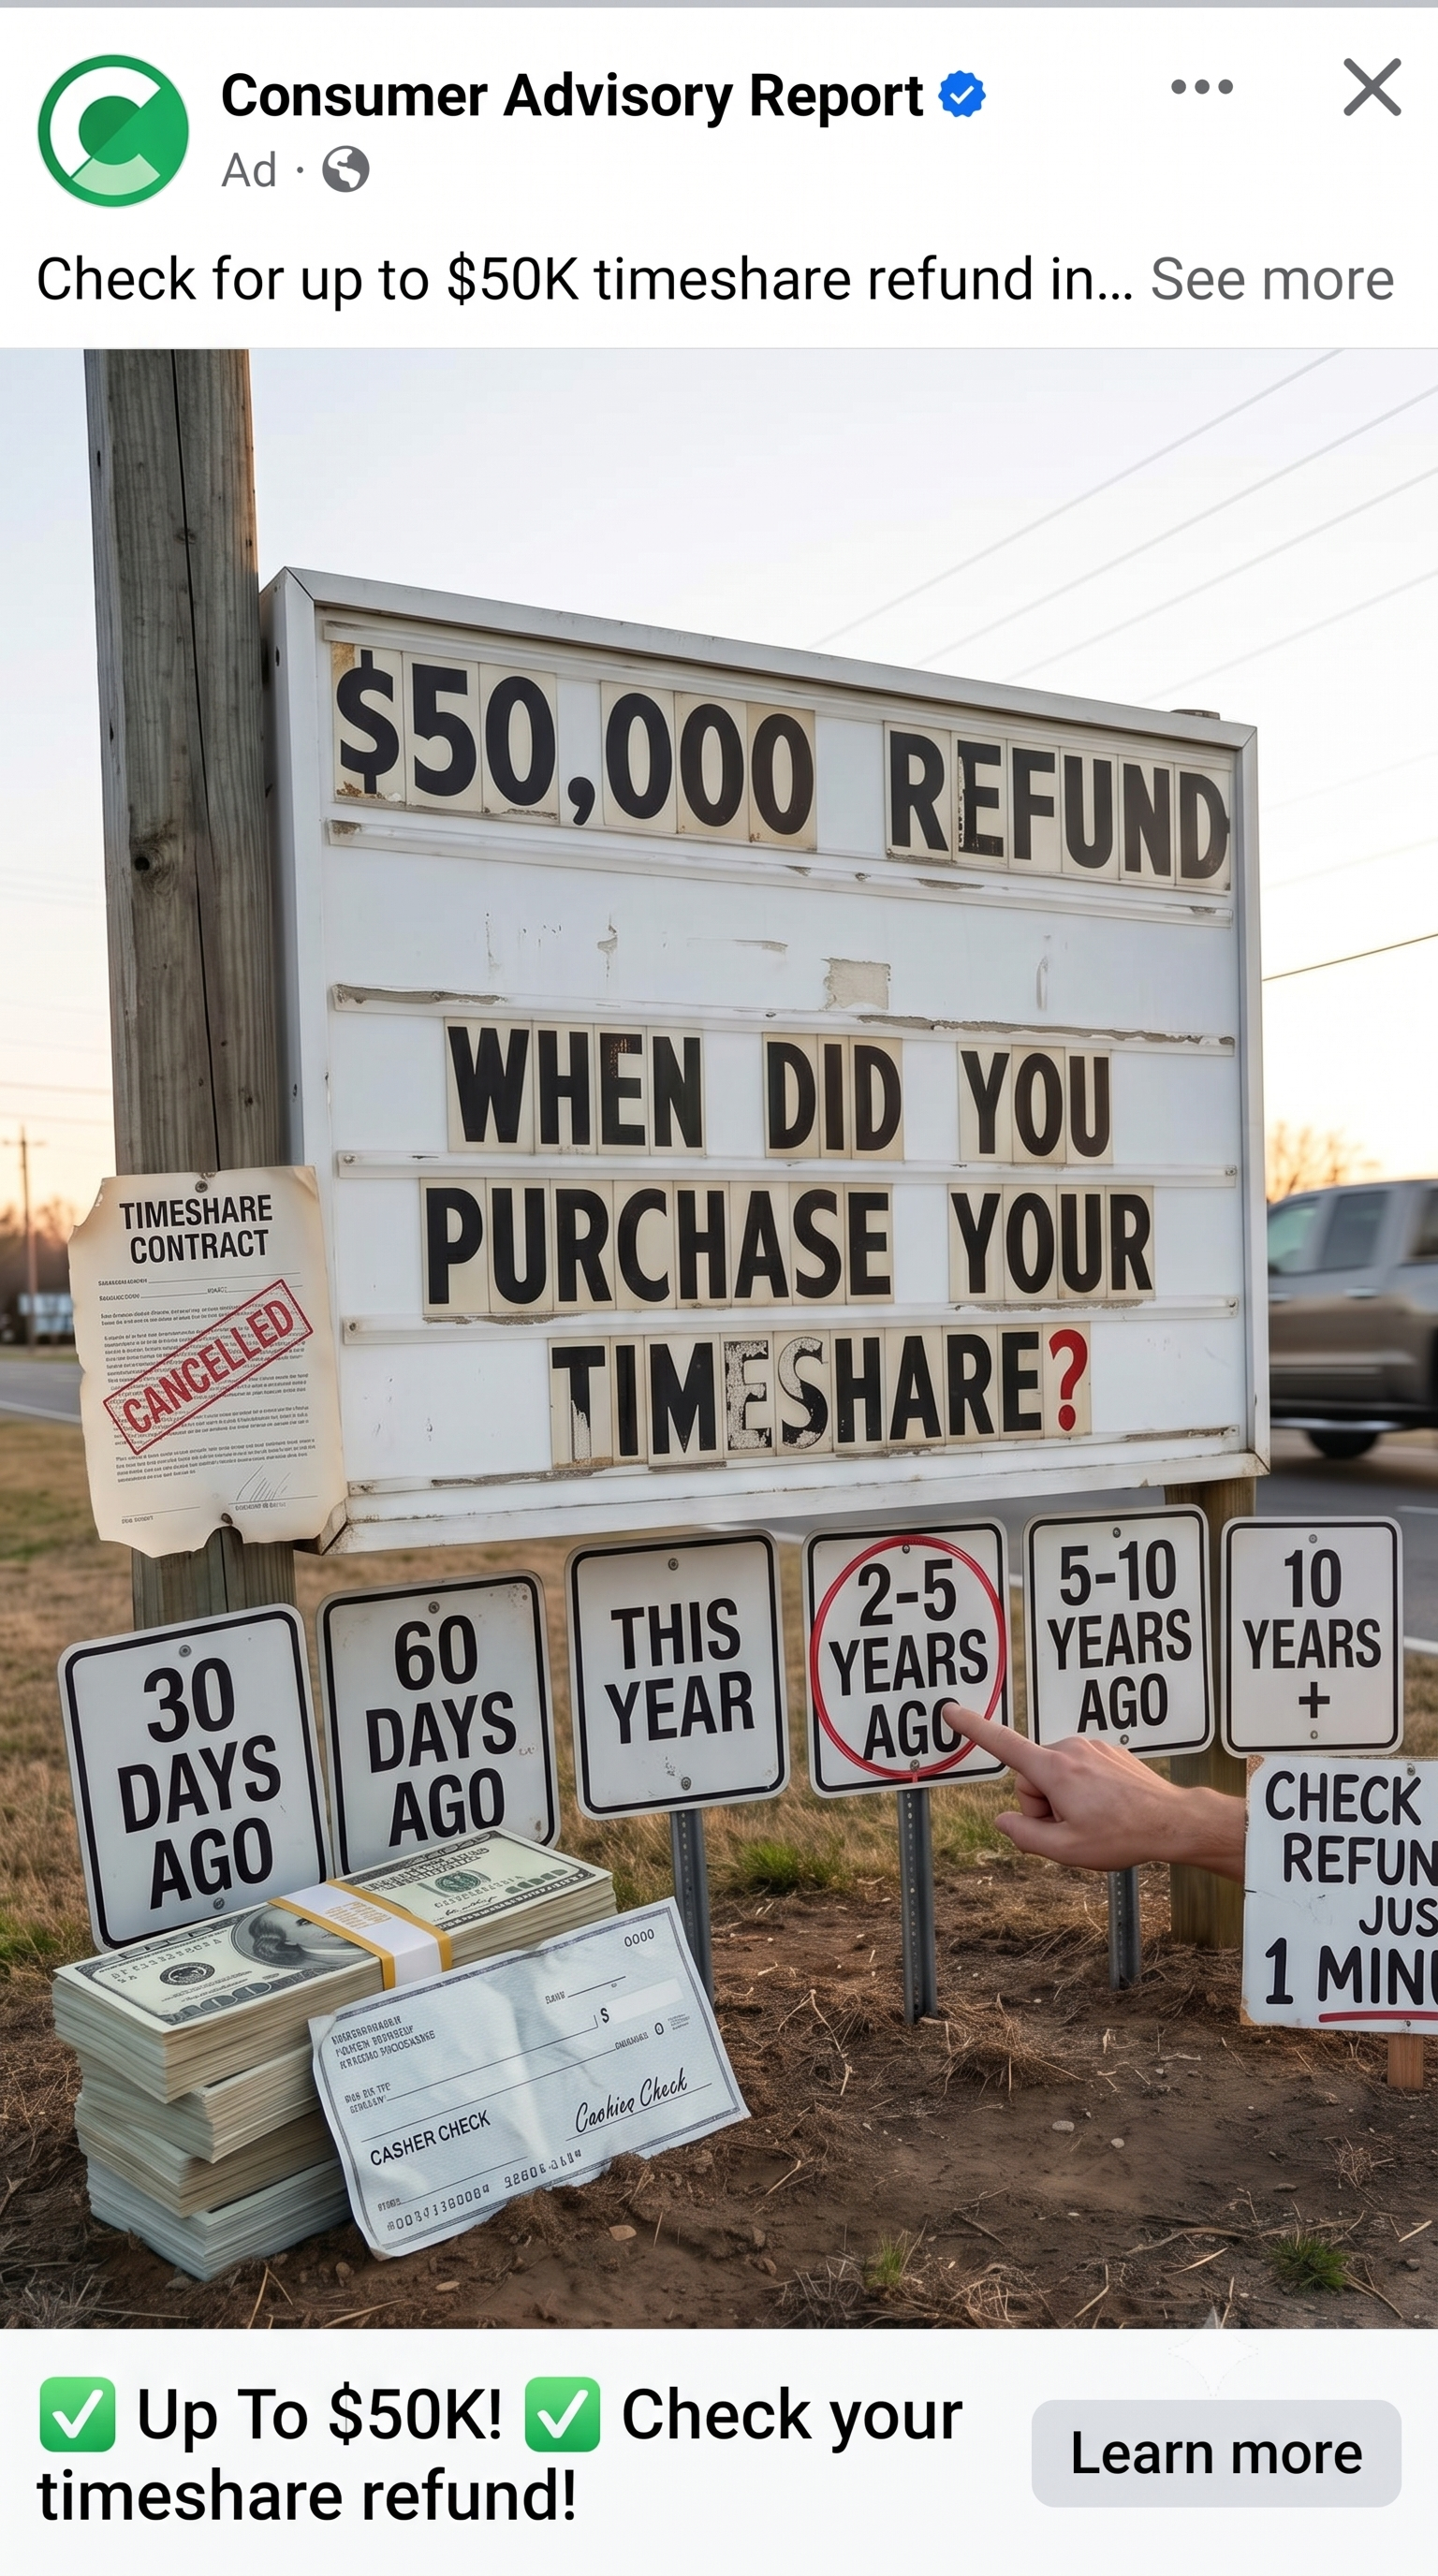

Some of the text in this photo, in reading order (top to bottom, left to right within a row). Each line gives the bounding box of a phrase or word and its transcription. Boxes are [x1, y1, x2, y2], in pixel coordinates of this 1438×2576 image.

[336, 649, 1230, 879] $50,000 REFUND
[448, 1026, 1109, 1157] WHEN DID YOU
[119, 1194, 272, 1229] TIMESHARE
[130, 1229, 269, 1264] CONTRACT
[426, 1187, 1152, 1304] PURCHASE YOUR
[123, 1300, 294, 1433] CANCELLED
[551, 1328, 1088, 1459] TIMESHARE?
[858, 1559, 956, 1627] 2-5
[1060, 1540, 1176, 1606] 5-10
[1284, 1549, 1341, 1608] 10
[394, 1615, 477, 1690] 60
[610, 1598, 741, 1669] THIS
[829, 1629, 988, 1696] YEARS
[1048, 1609, 1192, 1670] YEARS
[1242, 1618, 1381, 1669] YEARS
[143, 1658, 235, 1742] 30
[366, 1691, 517, 1773] DAYS
[605, 1671, 754, 1744] YEAR
[864, 1698, 962, 1760] AGO
[1078, 1674, 1167, 1733] AGO
[1299, 1682, 1330, 1719] +
[118, 1734, 281, 1833] DAYS
[389, 1768, 505, 1847] AGO
[1266, 1771, 1421, 1825] CHECK
[150, 1818, 272, 1910] AGO
[1284, 1833, 1438, 1886] REFUN
[1359, 1895, 1438, 1937] JUS
[1265, 1938, 1294, 2004] 1
[600, 2008, 609, 2023] $
[639, 2067, 688, 2106] Check
[371, 2110, 491, 2166] CASHER CHECK
